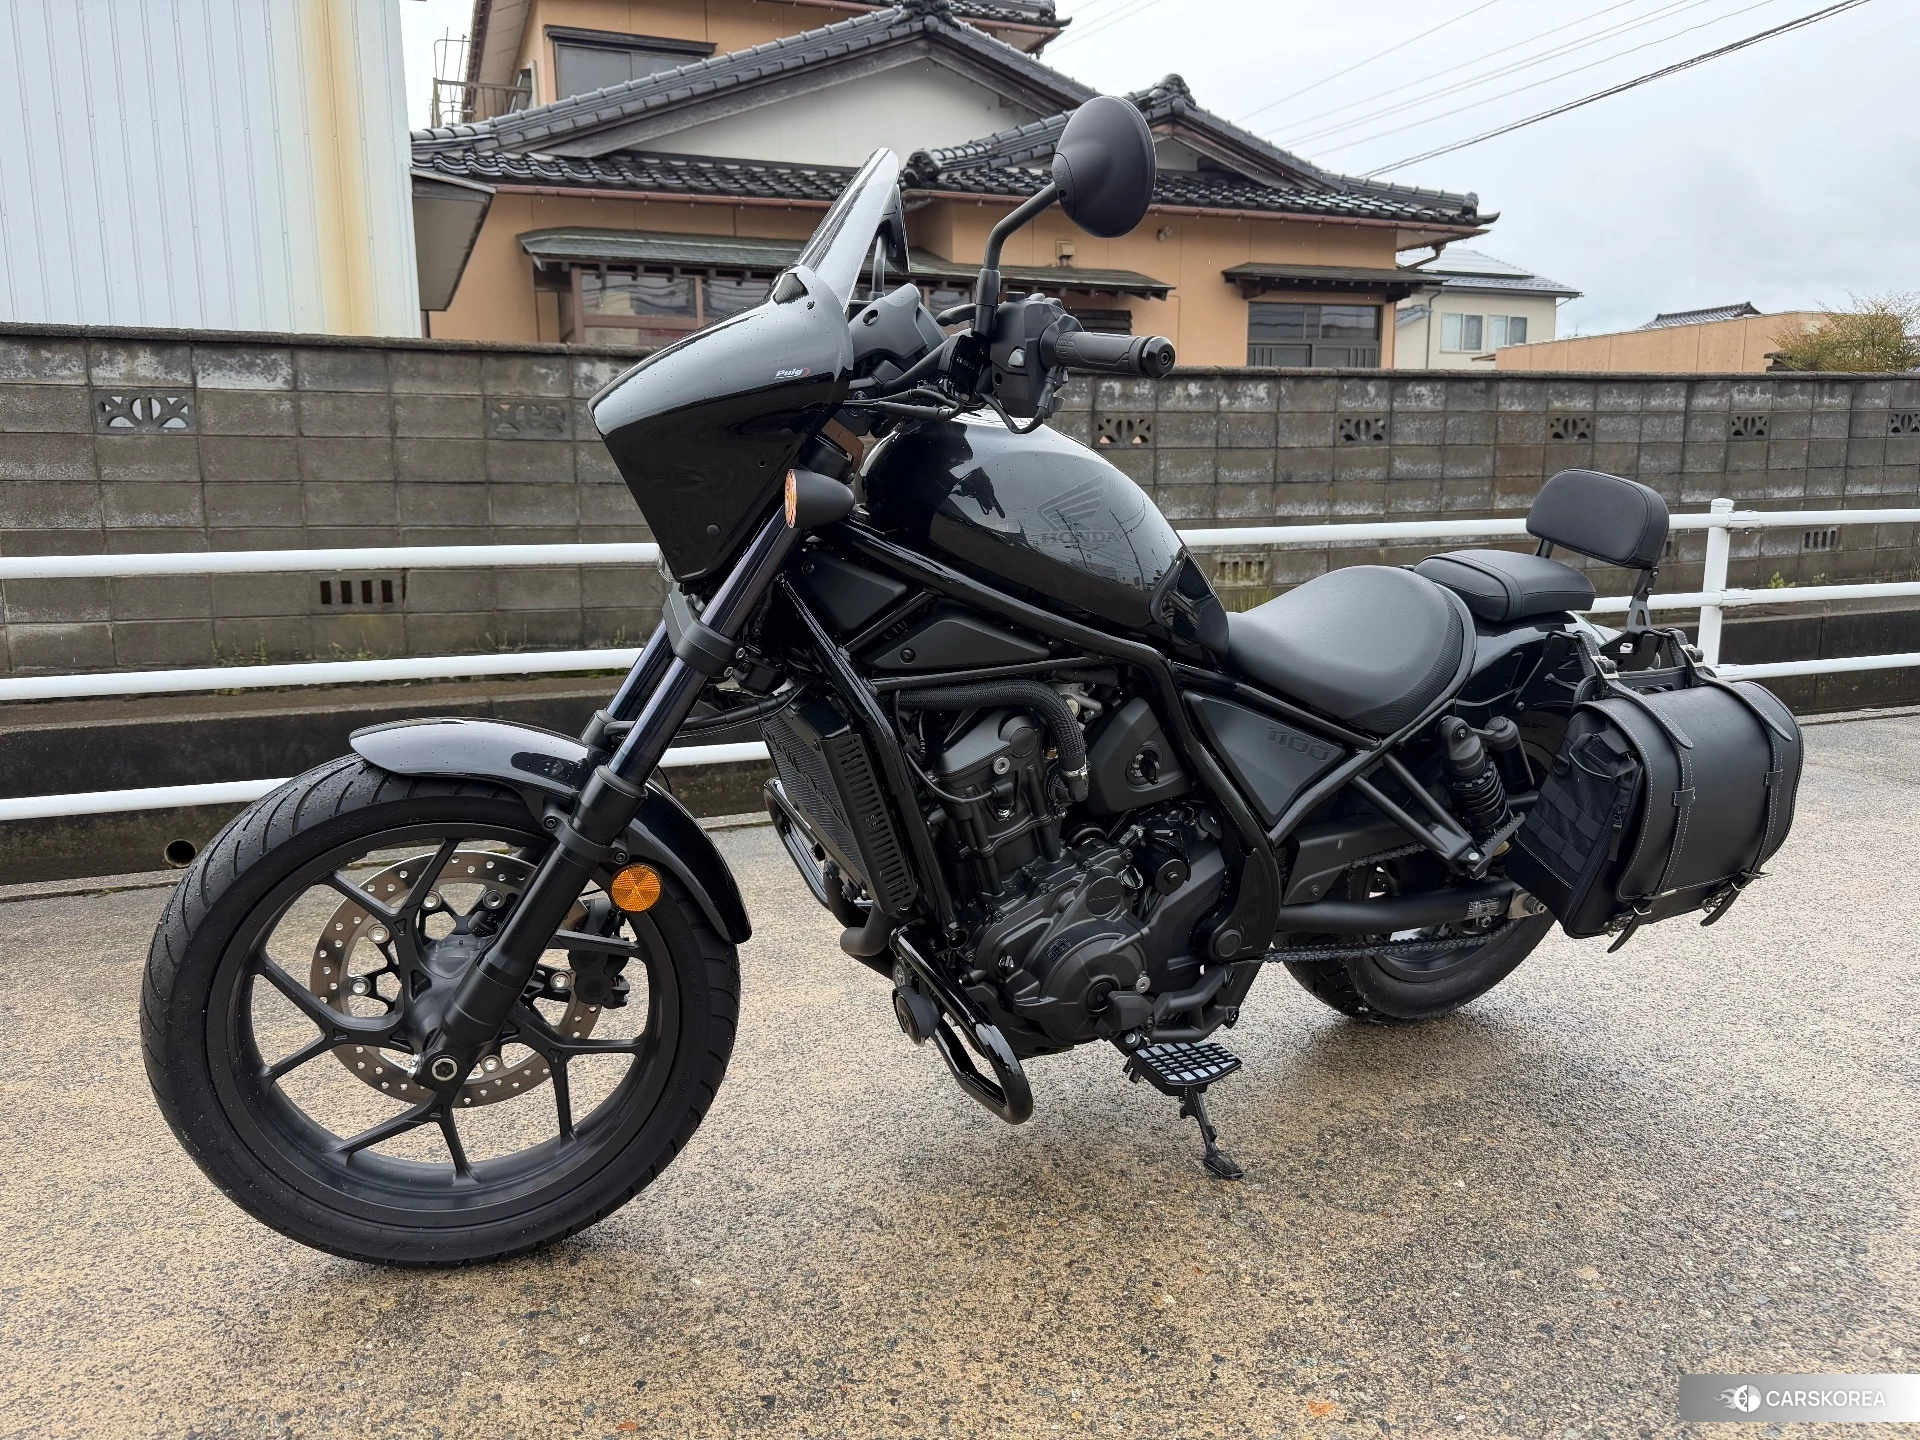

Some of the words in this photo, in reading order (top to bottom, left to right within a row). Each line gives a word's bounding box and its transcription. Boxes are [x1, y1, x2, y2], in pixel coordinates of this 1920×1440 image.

[775, 368, 804, 378] Puig
[1040, 531, 1121, 543] HONDA
[1267, 727, 1331, 761] 1100
